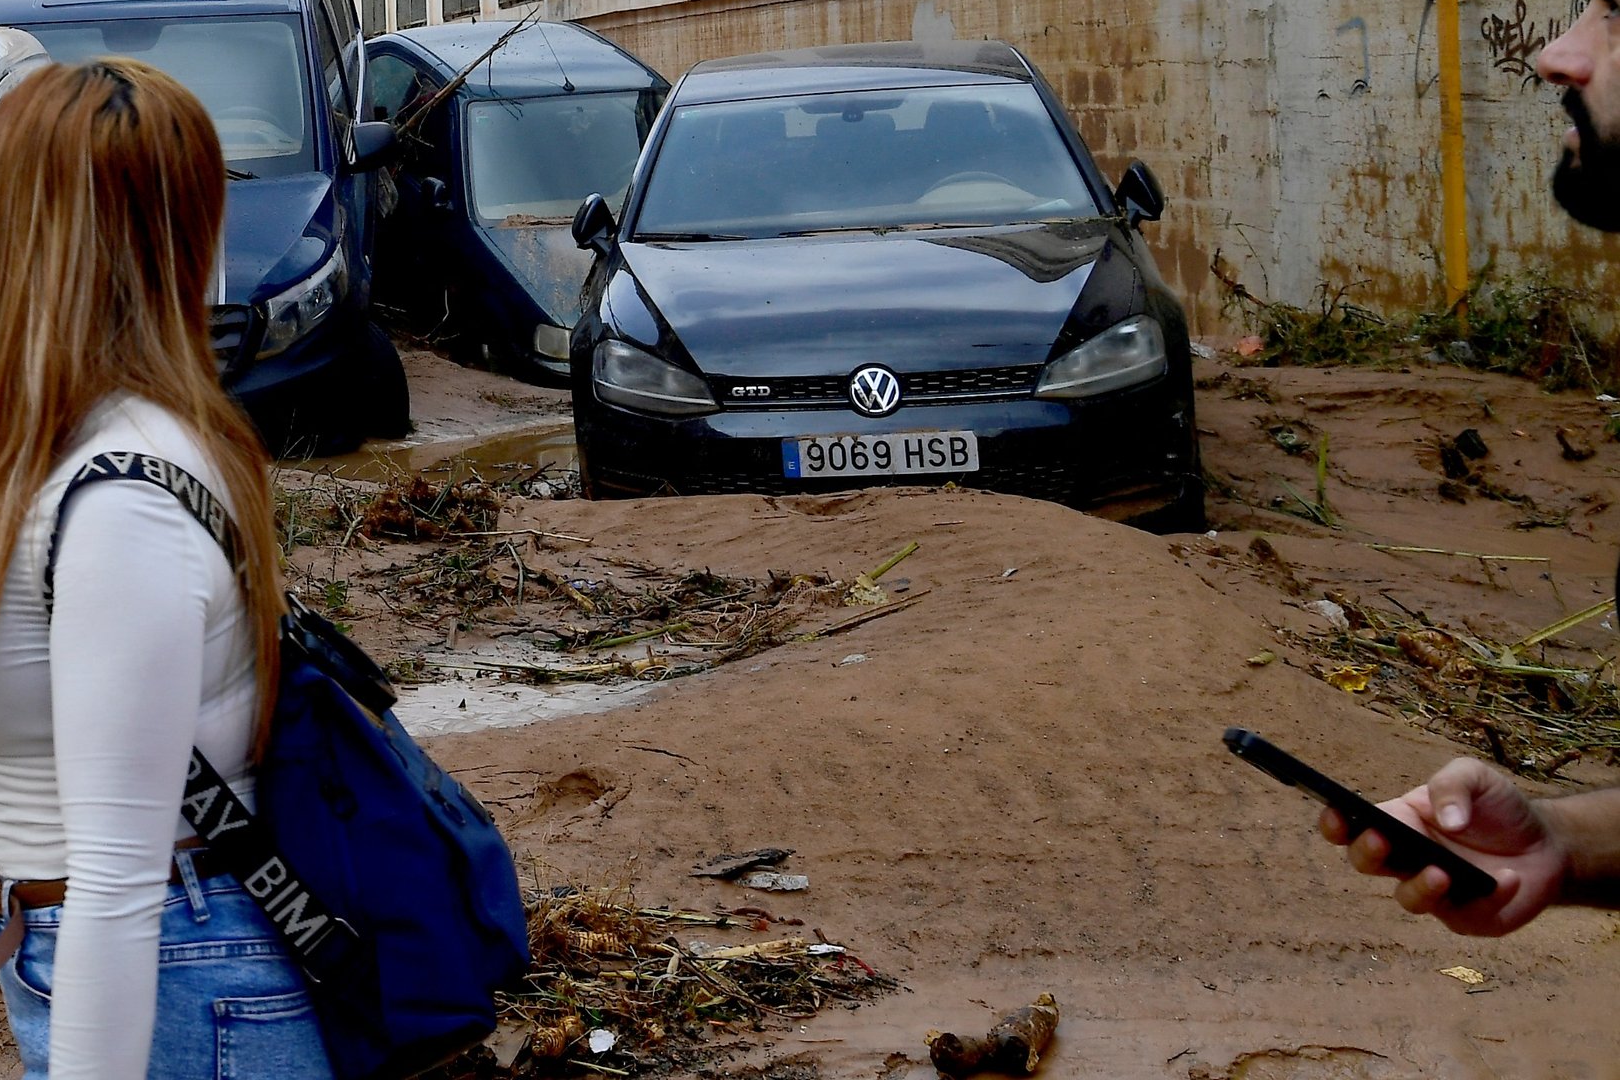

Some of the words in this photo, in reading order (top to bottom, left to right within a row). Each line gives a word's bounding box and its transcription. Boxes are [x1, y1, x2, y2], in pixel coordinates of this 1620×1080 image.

[731, 385, 771, 398] GTD
[806, 439, 892, 472] 9069
[904, 436, 969, 469] HSB
[788, 461, 796, 470] E
